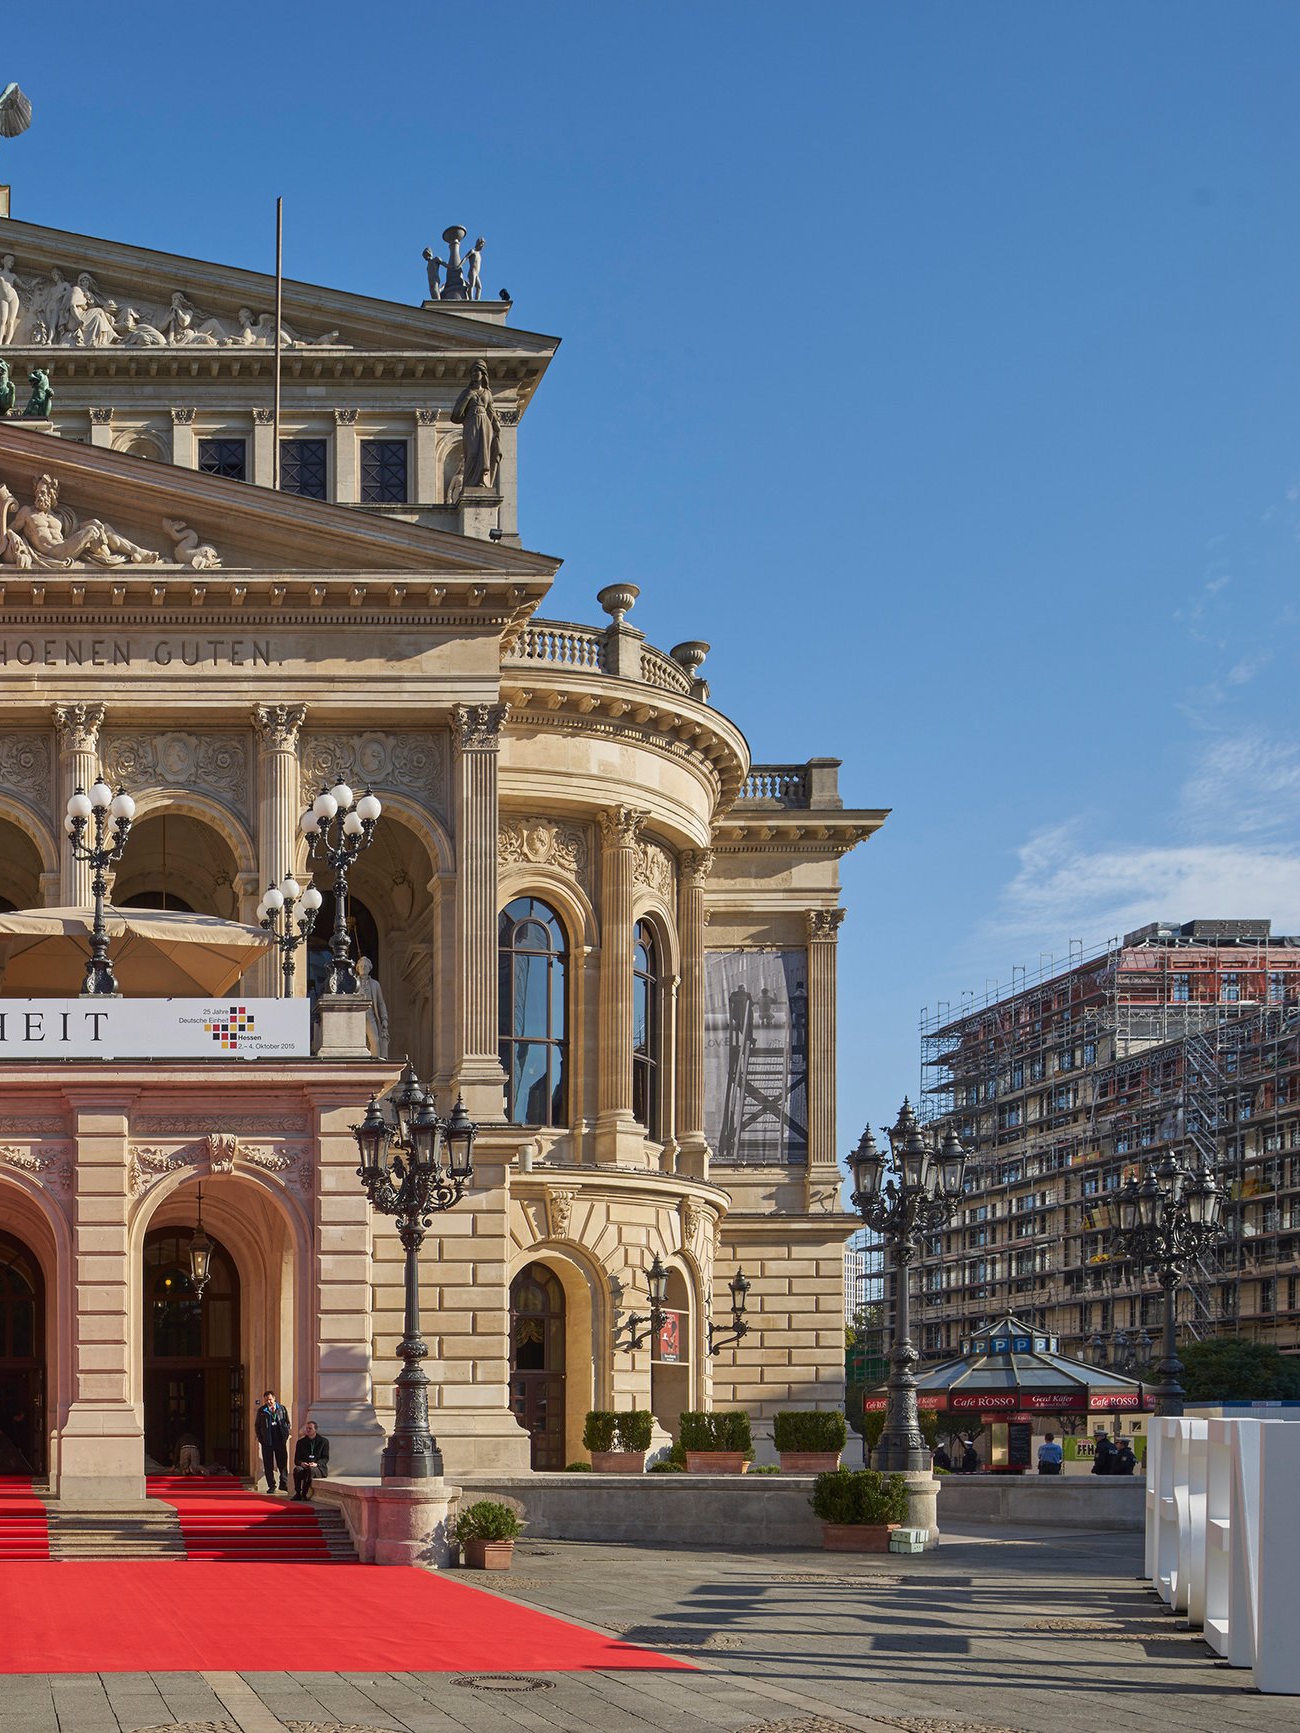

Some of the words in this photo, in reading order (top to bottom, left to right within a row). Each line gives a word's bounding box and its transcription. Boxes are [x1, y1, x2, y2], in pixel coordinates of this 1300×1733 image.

[976, 1342, 985, 1353] P
[995, 1341, 1006, 1352] P
[1017, 1341, 1027, 1352] P
[1036, 1341, 1045, 1352] P
[953, 1398, 976, 1407] Café
[978, 1397, 1015, 1406] ROSSO
[1090, 1397, 1109, 1407] Café
[1110, 1397, 1139, 1406] ROSSO
[1077, 1444, 1095, 1456] FFH
